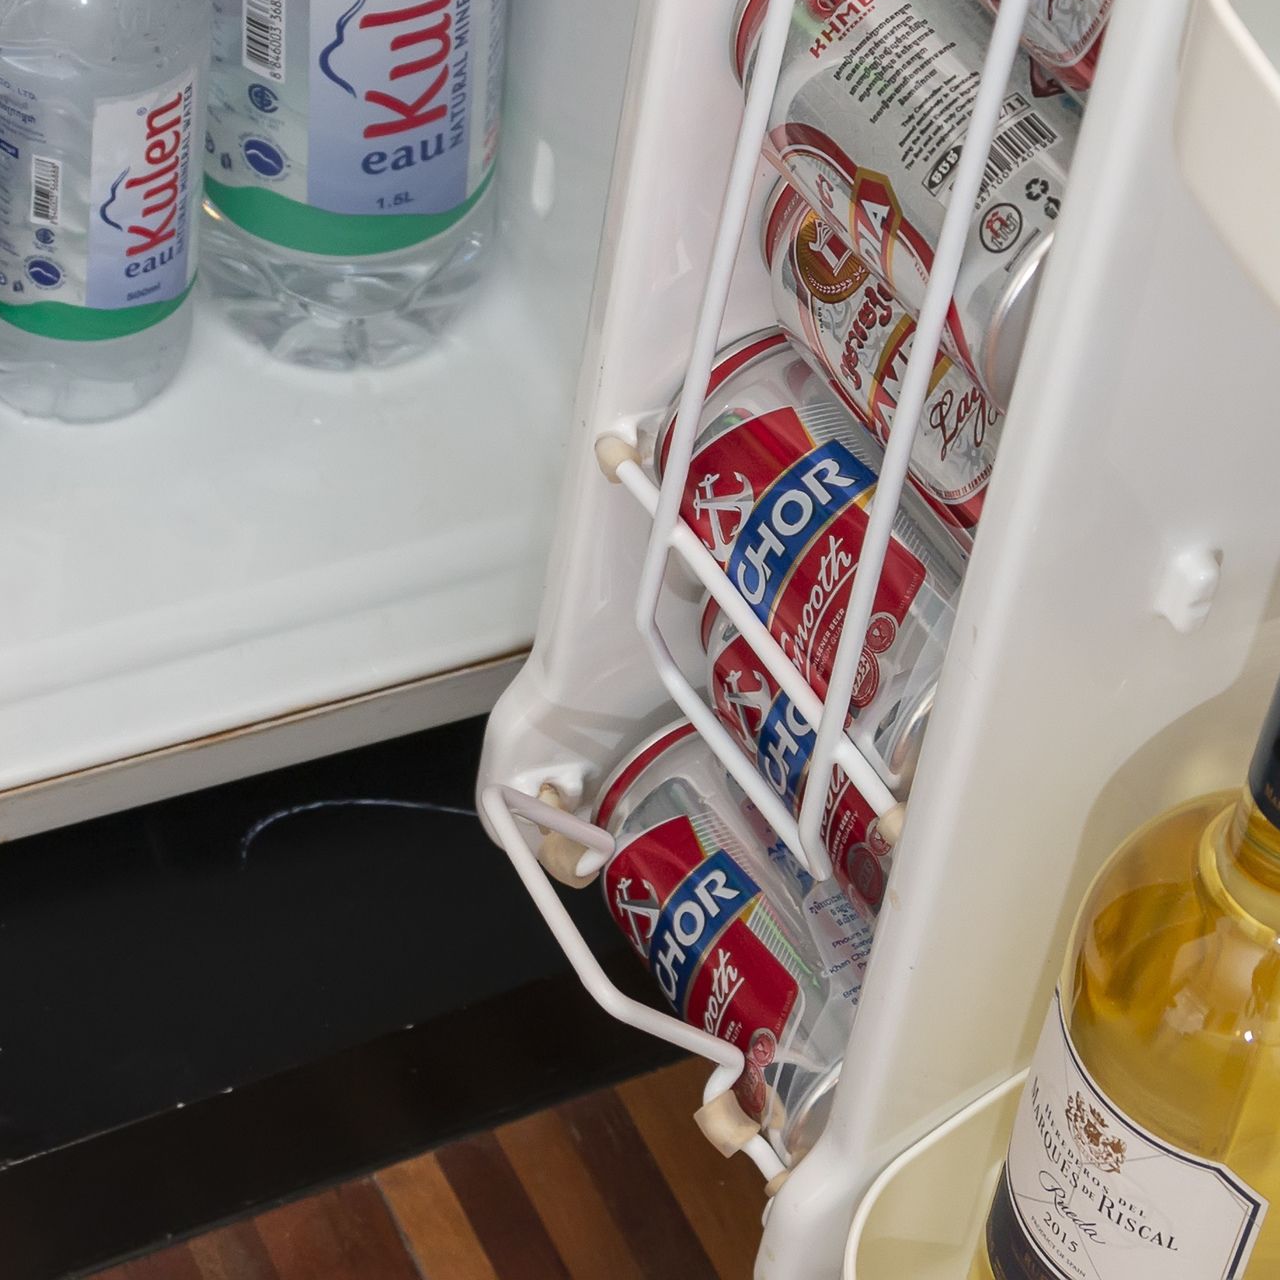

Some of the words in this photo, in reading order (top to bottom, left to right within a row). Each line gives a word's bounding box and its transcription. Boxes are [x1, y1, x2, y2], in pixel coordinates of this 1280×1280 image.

[182, 82, 194, 133] WATER
[449, 50, 468, 149] NATURAL
[125, 91, 183, 257] Kulen
[361, 132, 445, 175] eau
[377, 191, 415, 208] 1.5L
[124, 247, 174, 278] eau
[736, 458, 856, 605] CHOR
[831, 608, 845, 630] BEER
[765, 702, 818, 795] CHO
[656, 869, 740, 1002] CHOR
[703, 948, 738, 1036] ooth
[1045, 1104, 1109, 1195] HEREDEROS
[1118, 1197, 1146, 1219] DEL
[1038, 1170, 1105, 1245] Rueda
[1043, 1211, 1078, 1253] 2015
[1081, 1185, 1095, 1201] DE
[1097, 1193, 1179, 1251] RISCAL
[1031, 1215, 1056, 1250] PRODUCT
[1065, 1258, 1086, 1278] SPAIN
